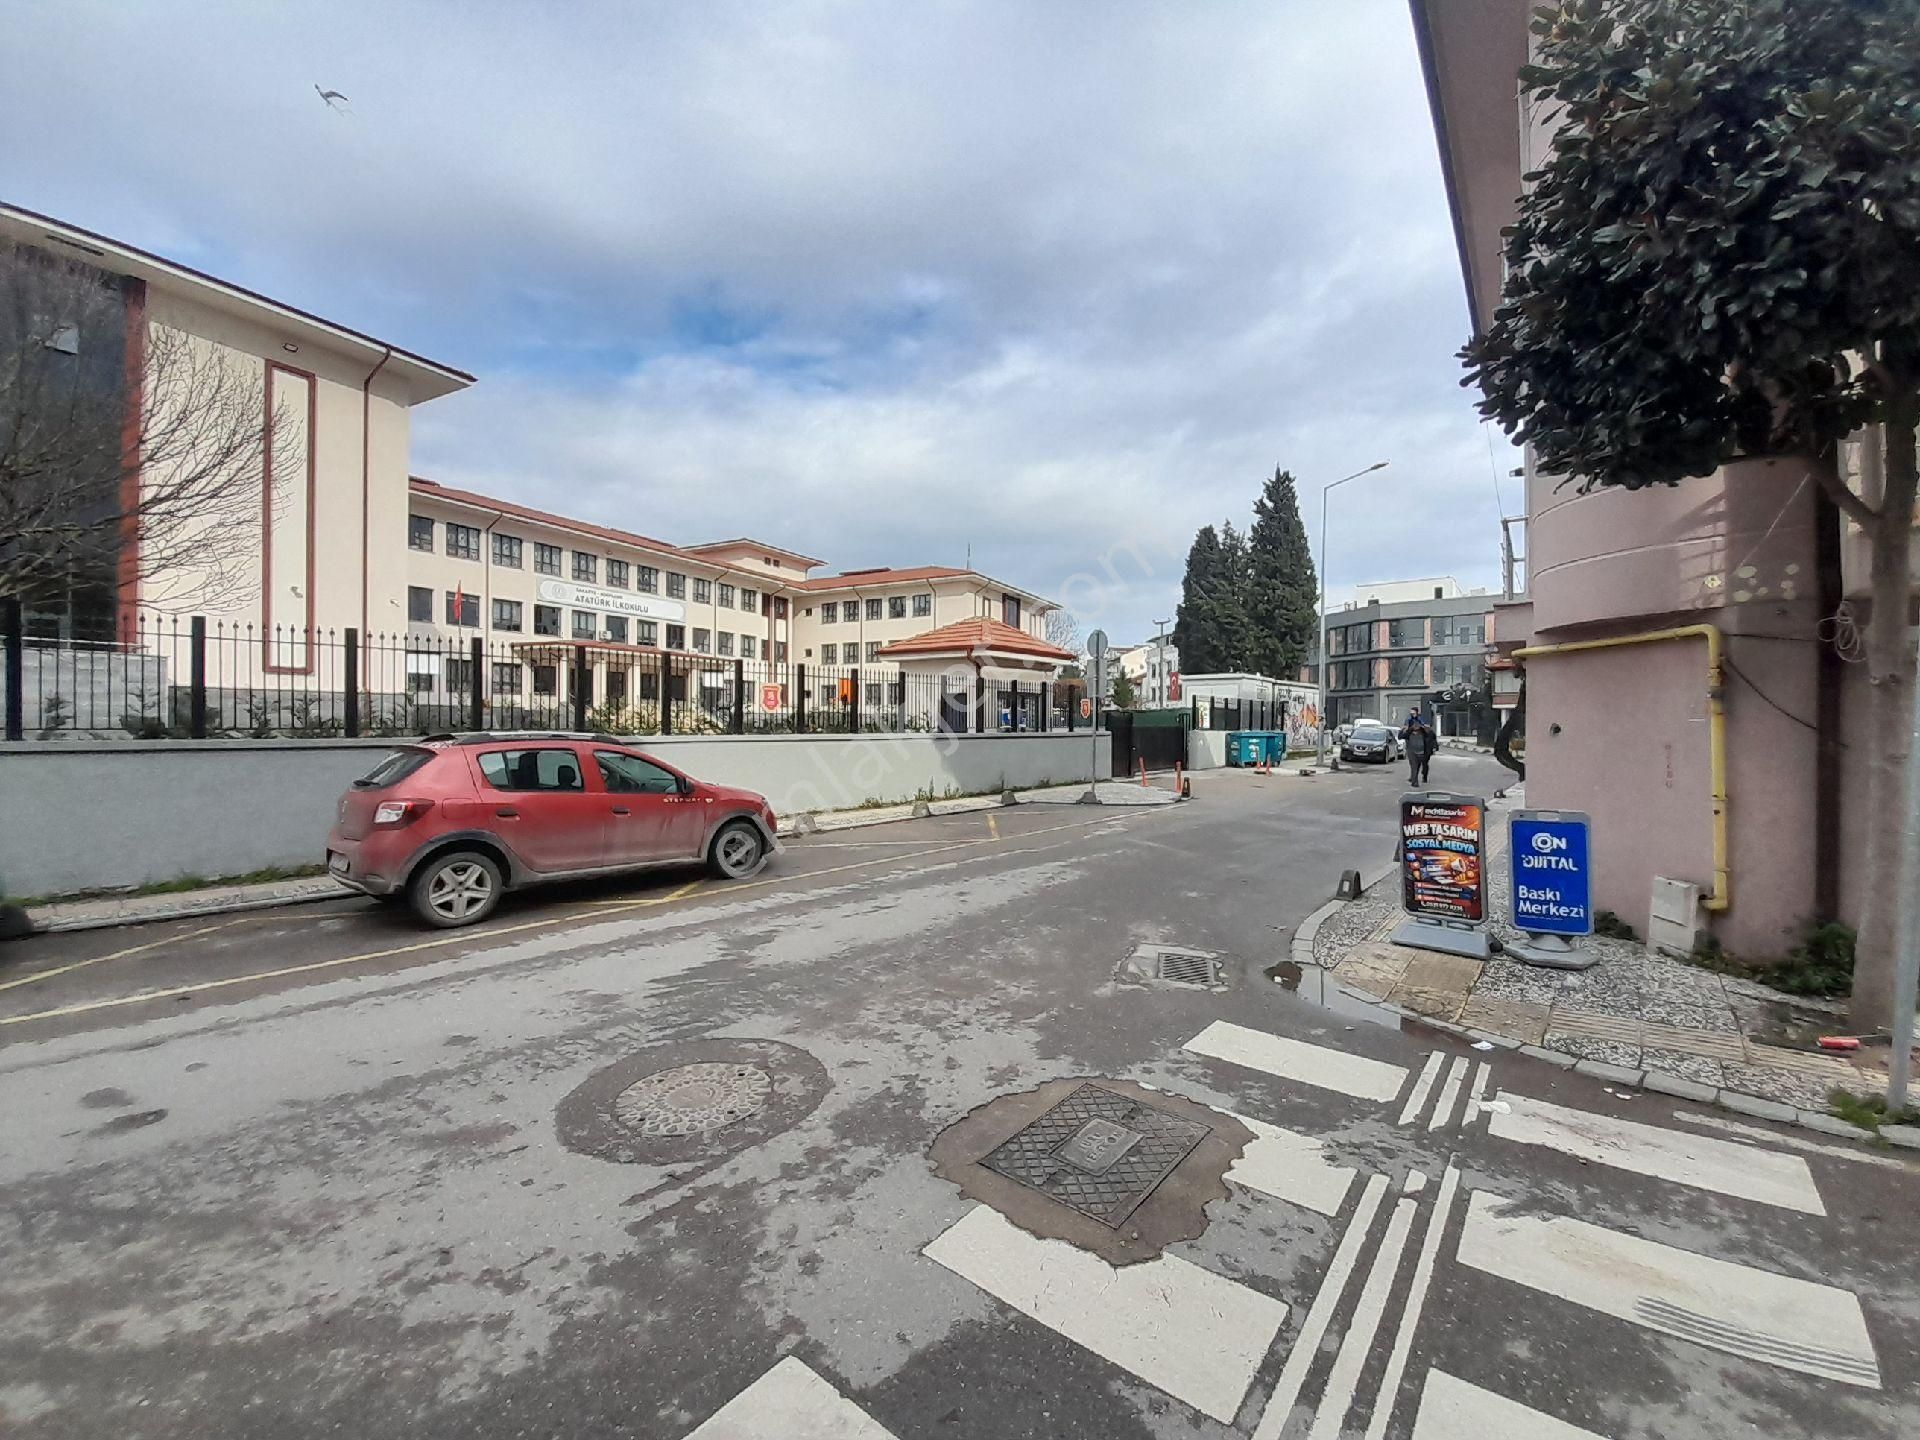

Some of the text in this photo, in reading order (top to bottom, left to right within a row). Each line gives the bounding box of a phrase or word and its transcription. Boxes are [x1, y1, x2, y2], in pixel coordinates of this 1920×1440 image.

[575, 595, 611, 607] ATATÜRK
[1403, 824, 1478, 841] WEB TASARIM
[1406, 839, 1475, 855] SOSYAL MEDYA
[1532, 833, 1568, 853] ON
[1518, 885, 1560, 901] Baskı
[1518, 900, 1584, 918] Merkezi
